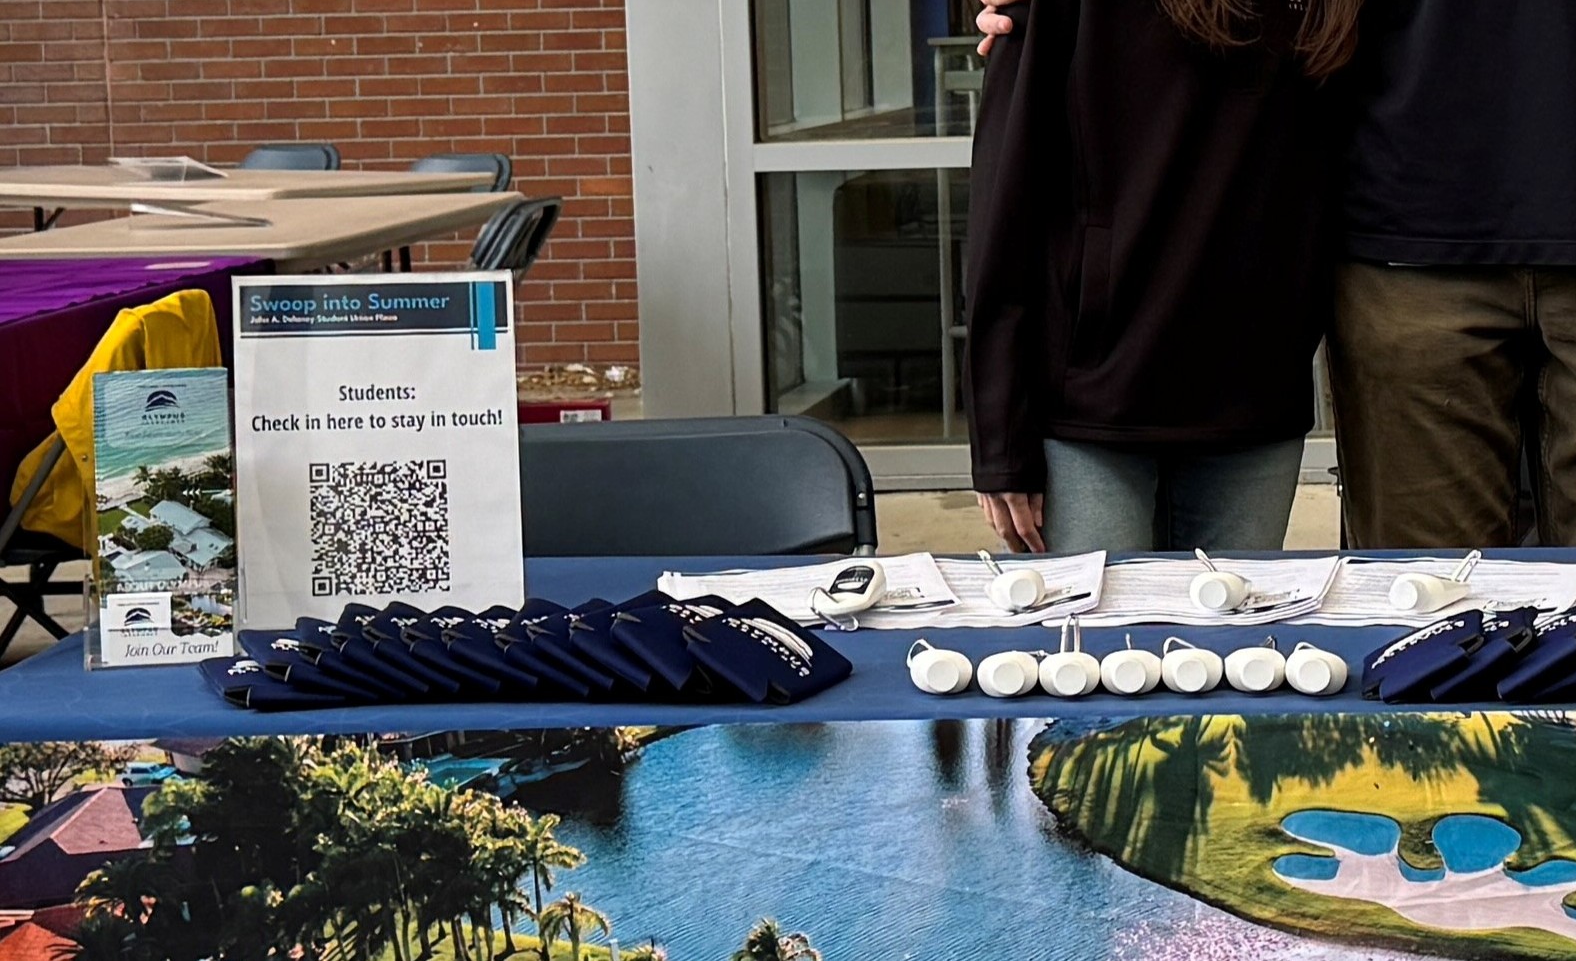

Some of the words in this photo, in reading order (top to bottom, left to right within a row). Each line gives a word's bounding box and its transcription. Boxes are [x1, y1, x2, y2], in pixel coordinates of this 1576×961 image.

[250, 294, 317, 319] Swoop
[323, 294, 361, 311] into
[368, 293, 450, 310] Summer
[339, 384, 416, 401] Students:
[251, 414, 300, 432] Check
[305, 414, 321, 430] in
[326, 414, 364, 429] here
[369, 414, 386, 429] to
[391, 413, 425, 432] stay
[431, 410, 446, 427] in
[451, 409, 503, 426] touch!
[125, 643, 149, 657] Join
[152, 642, 178, 656] Our
[181, 640, 220, 655] Team!
